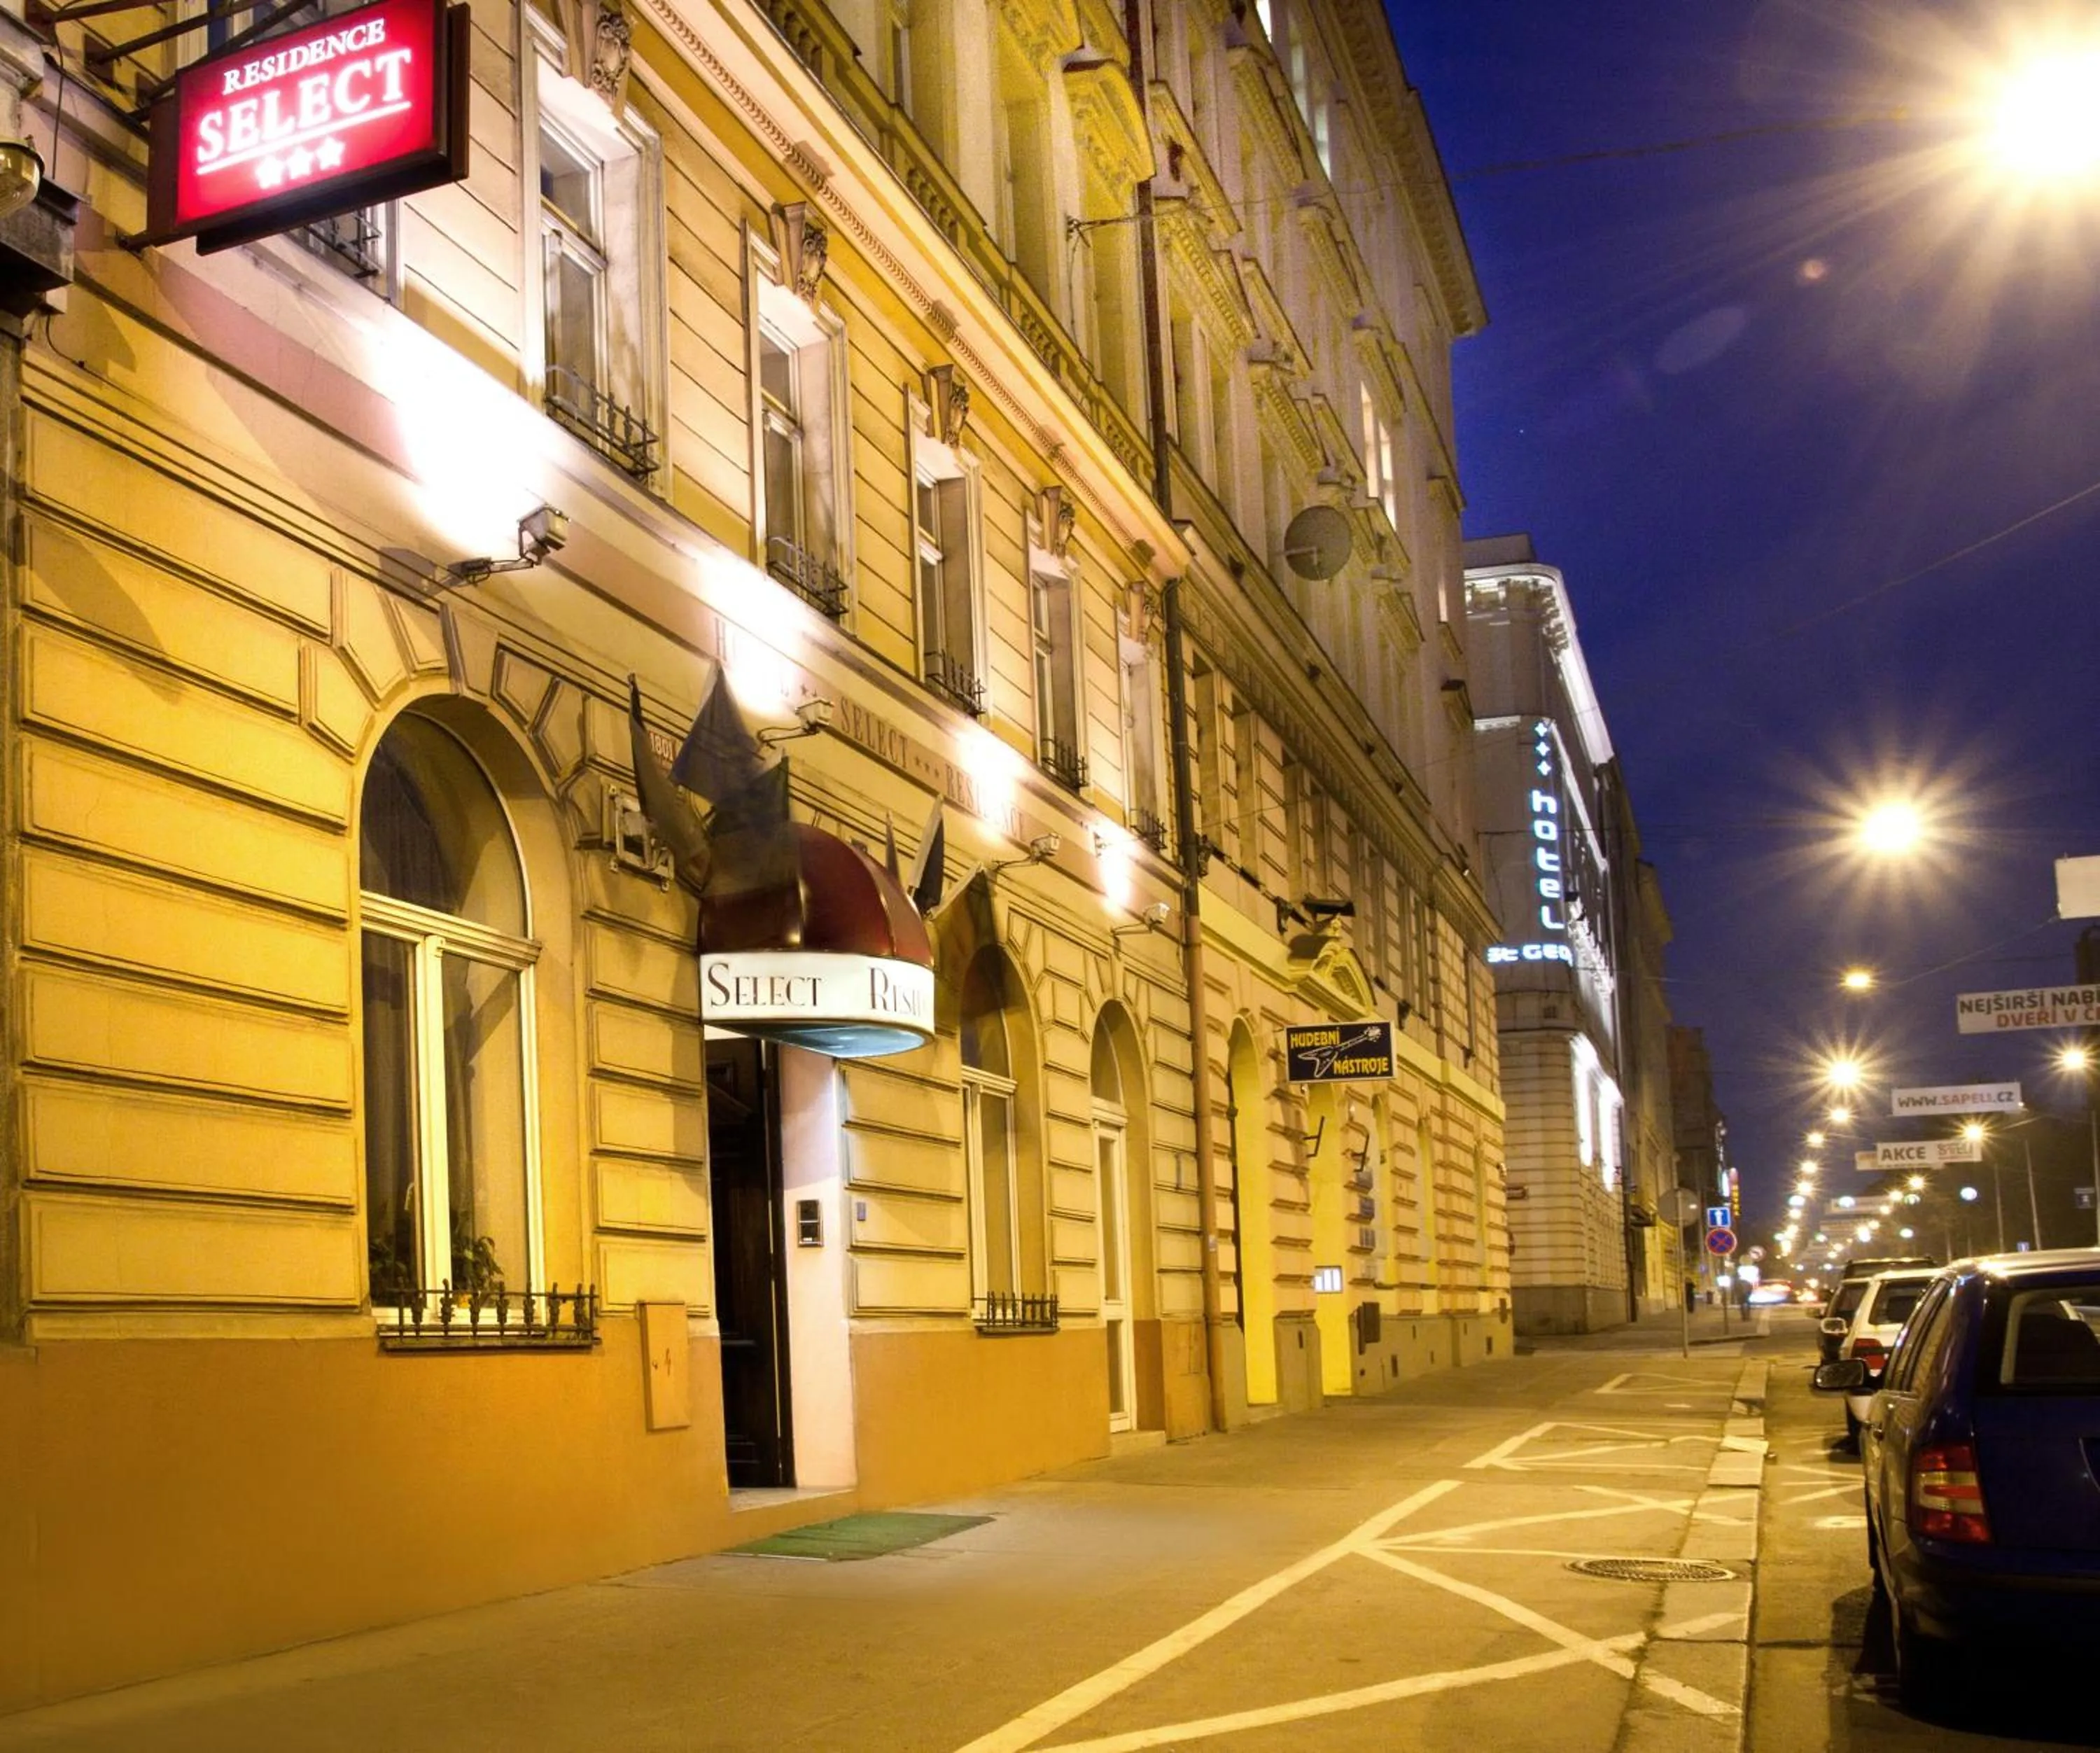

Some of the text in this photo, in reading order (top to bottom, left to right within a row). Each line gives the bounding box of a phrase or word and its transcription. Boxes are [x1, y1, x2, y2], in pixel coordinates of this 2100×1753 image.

[223, 18, 386, 95] RESIDENCE
[197, 48, 412, 163] SELECT
[840, 696, 908, 769] SELECT
[1959, 988, 2045, 1014] NEJŠIRŠÍ
[2064, 1007, 2078, 1023] V
[1290, 1026, 1340, 1049] HUDEBNÍ
[1334, 1055, 1390, 1075] NÁSTROJE
[1880, 1145, 1926, 1161] AKCE
